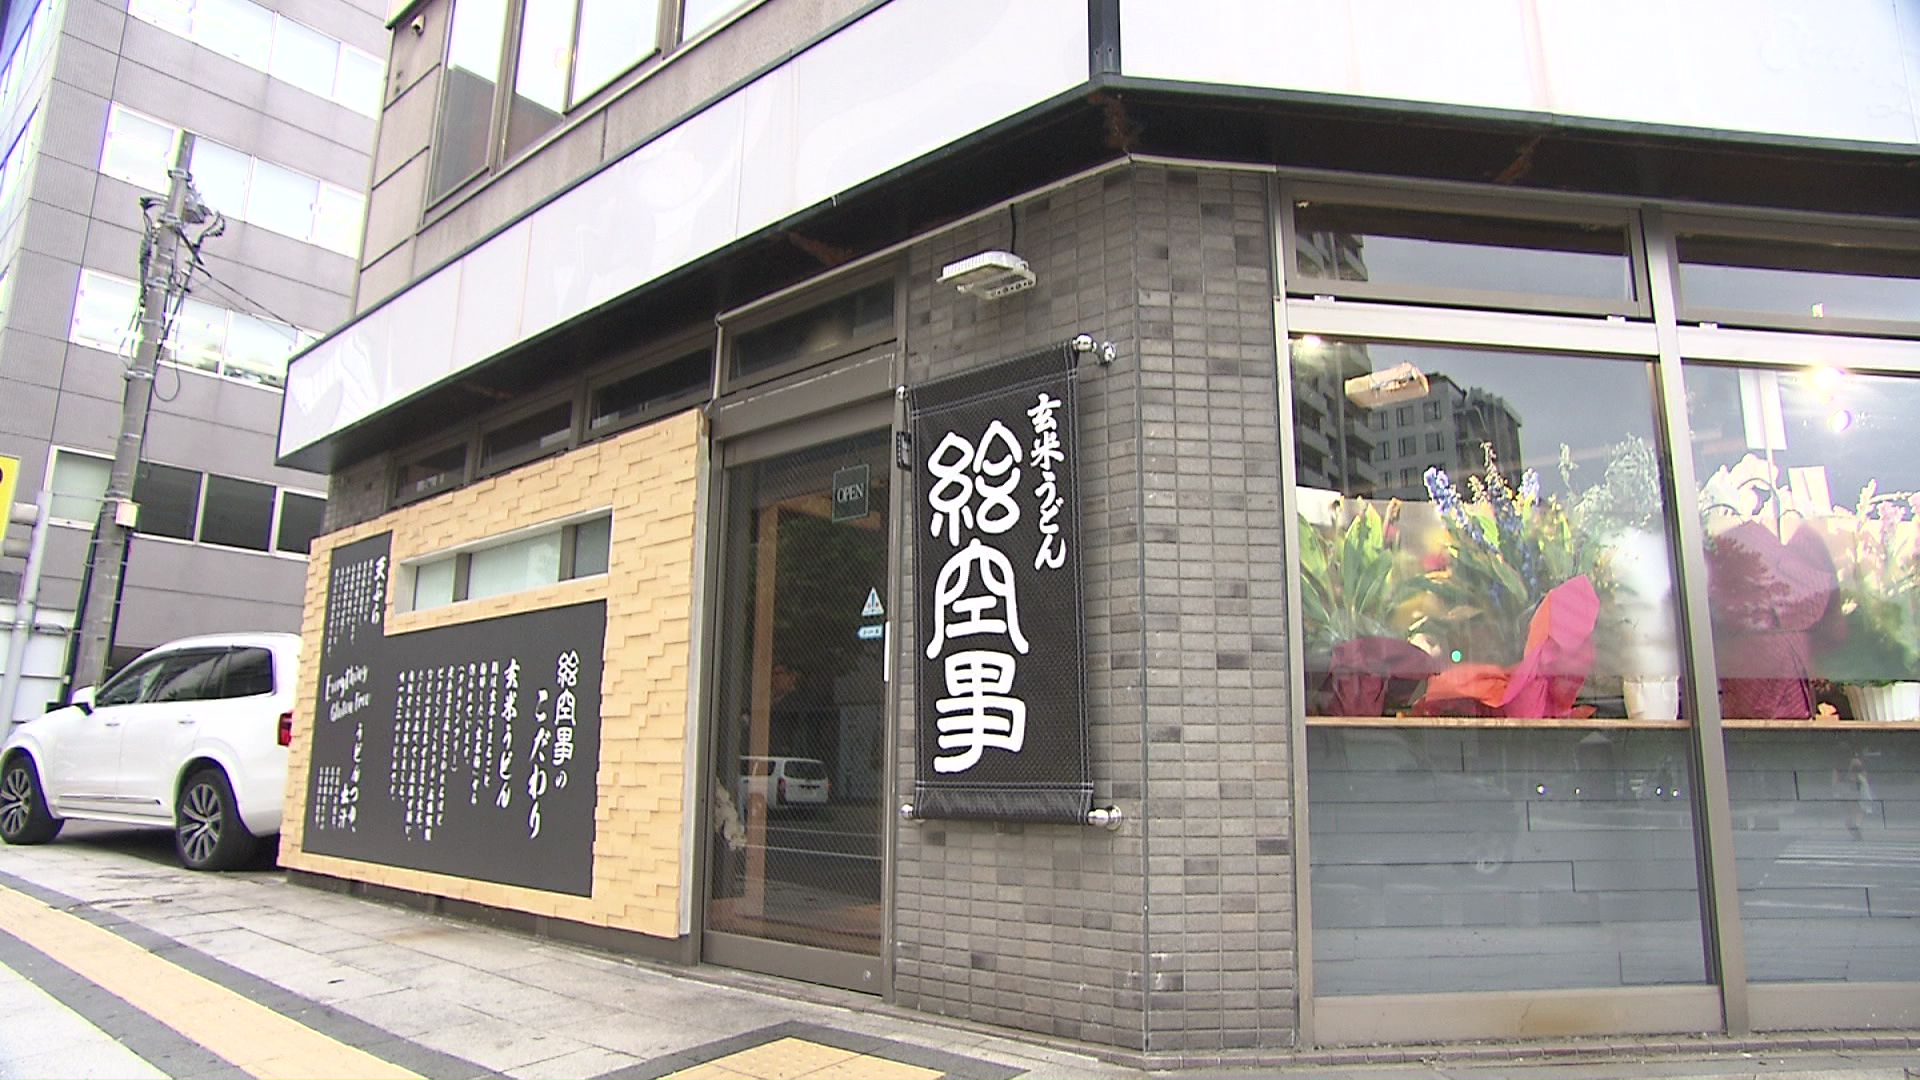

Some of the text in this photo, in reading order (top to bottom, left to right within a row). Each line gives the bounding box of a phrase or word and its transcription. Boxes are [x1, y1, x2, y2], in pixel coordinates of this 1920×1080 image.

[836, 484, 865, 504] OPEN
[1027, 392, 1067, 570] 玄米うどん
[926, 420, 1029, 773] 絵空事
[496, 657, 521, 810] 玄米うどん
[528, 688, 552, 839] こだわり
[553, 649, 580, 789] 絵空事の
